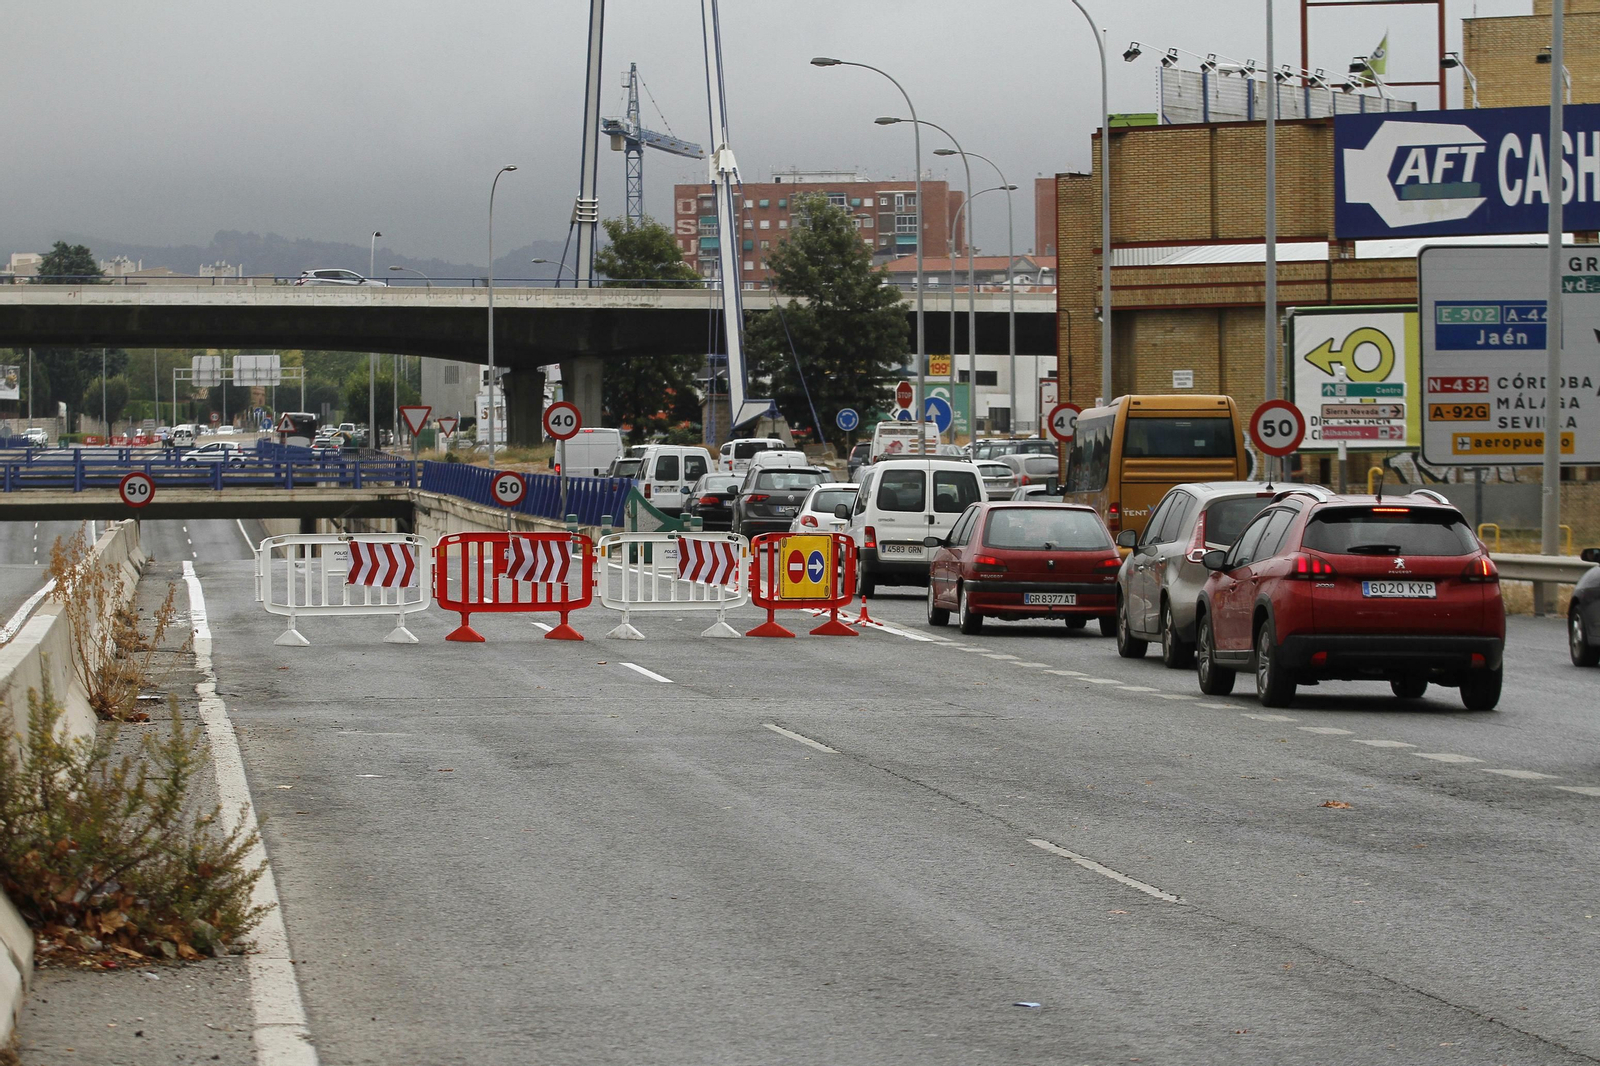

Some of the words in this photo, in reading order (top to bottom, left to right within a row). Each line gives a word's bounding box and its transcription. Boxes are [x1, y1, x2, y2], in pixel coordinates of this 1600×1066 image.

[1395, 145, 1487, 186] AFT
[1497, 131, 1600, 207] CASH
[1568, 256, 1599, 272] GR
[1441, 309, 1496, 322] E-902
[1506, 308, 1548, 322] A-44
[1476, 327, 1529, 346] Jaén
[1429, 379, 1488, 392] N-432
[897, 391, 912, 399] STOP
[1432, 406, 1488, 419] A-92G
[551, 414, 575, 427] 40
[1054, 416, 1078, 429] 40
[1497, 416, 1577, 429] SEVIA
[1262, 419, 1293, 438] 50
[1474, 438, 1570, 450] aeropueo
[127, 483, 149, 496] 50
[499, 482, 519, 494] 50
[887, 545, 905, 554] 4583
[908, 546, 922, 554] GRN
[1370, 582, 1405, 594] 6020
[1408, 583, 1433, 594] KXP
